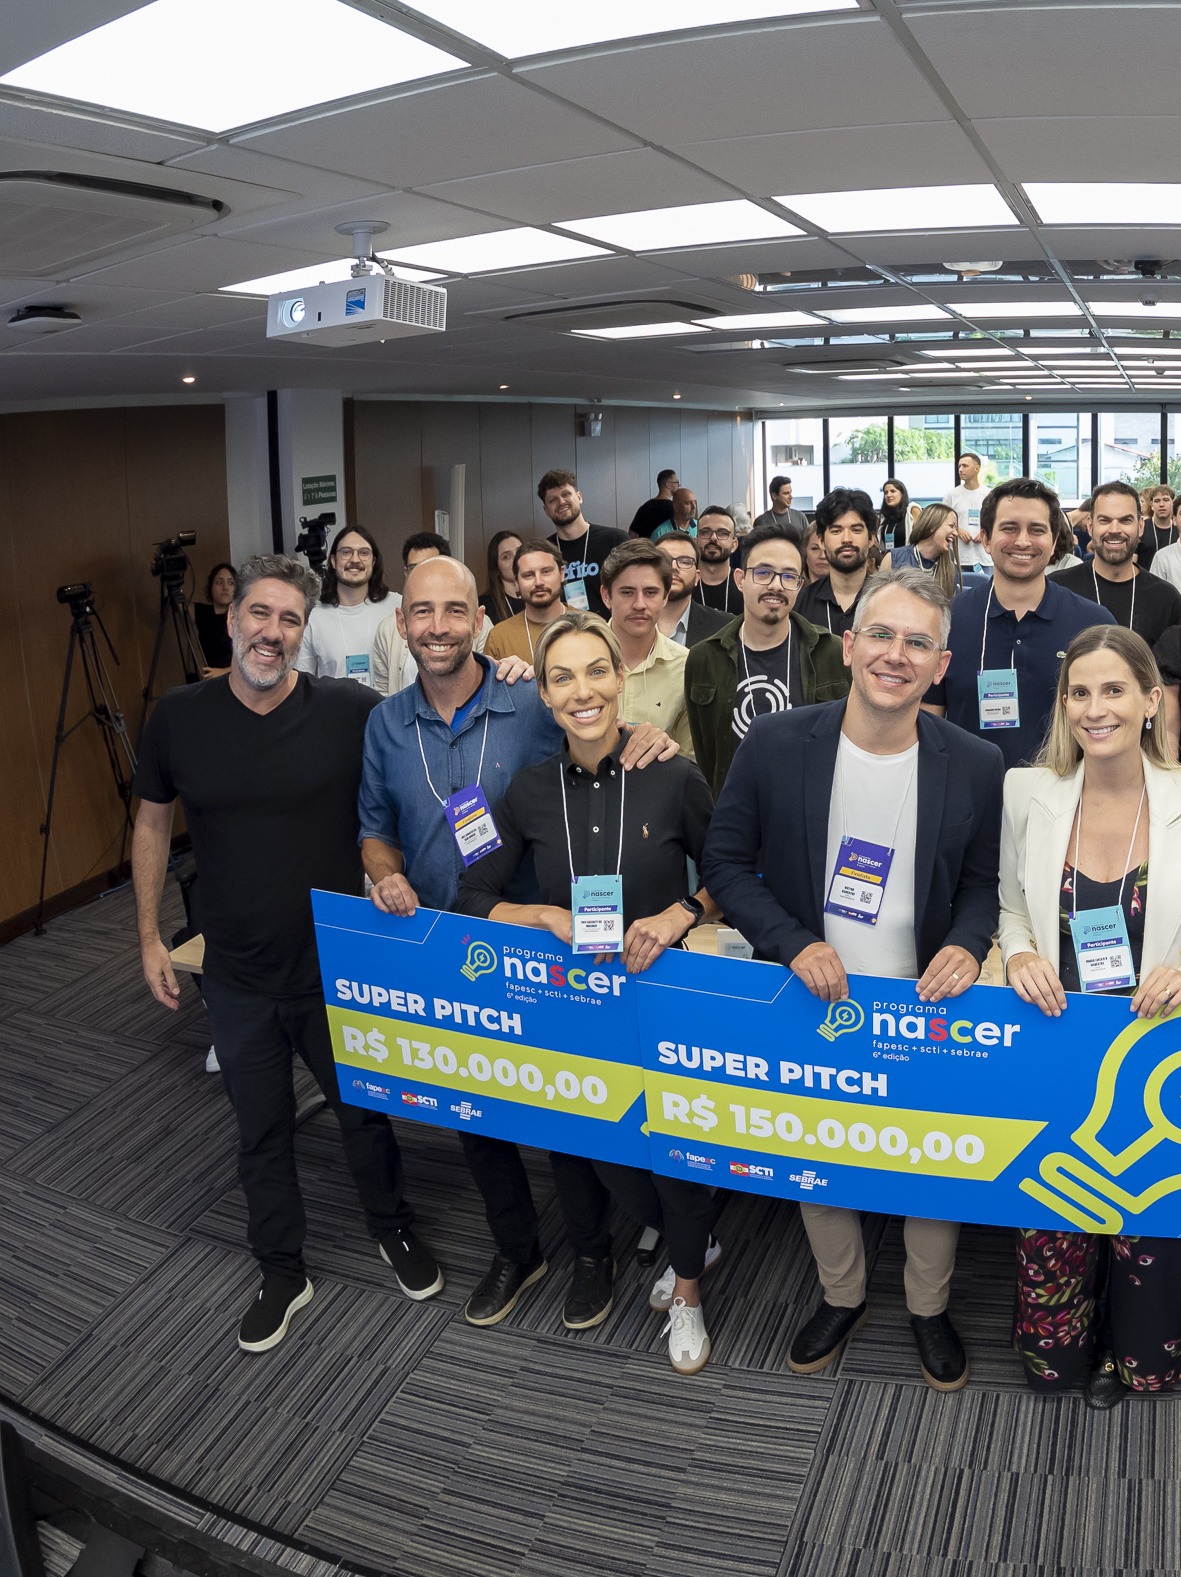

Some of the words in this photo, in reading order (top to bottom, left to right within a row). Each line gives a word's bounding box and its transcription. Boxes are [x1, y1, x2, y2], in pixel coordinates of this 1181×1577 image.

[858, 856, 882, 867] nascer
[1092, 924, 1116, 932] nascer
[503, 946, 563, 962] programa
[1086, 940, 1116, 948] Participante
[503, 956, 626, 996] nascer
[506, 981, 536, 994] fapesc
[544, 989, 562, 998] scti
[570, 994, 602, 1005] sebrae
[514, 994, 537, 1004] edição
[336, 978, 426, 1017] SUPER
[434, 998, 522, 1036] PITCH
[873, 1001, 947, 1014] programa
[872, 1012, 1020, 1047] nascer
[873, 1040, 909, 1051] fapesc
[920, 1044, 940, 1054] scti
[951, 1048, 988, 1059] sebrae
[882, 1052, 909, 1062] edição
[342, 1025, 389, 1063] R$
[396, 1037, 608, 1105] 130.000,00
[657, 1041, 769, 1081] SUPER
[780, 1061, 888, 1097] PITCH
[366, 1082, 390, 1094] fapesc
[417, 1095, 438, 1106] SCTI
[450, 1105, 482, 1117] SEBRAE
[662, 1091, 718, 1133] R$
[730, 1103, 985, 1164] 150.000,00
[686, 1152, 716, 1164] fapesc
[749, 1165, 774, 1177] SCTI
[789, 1174, 828, 1186] SEBRAE
